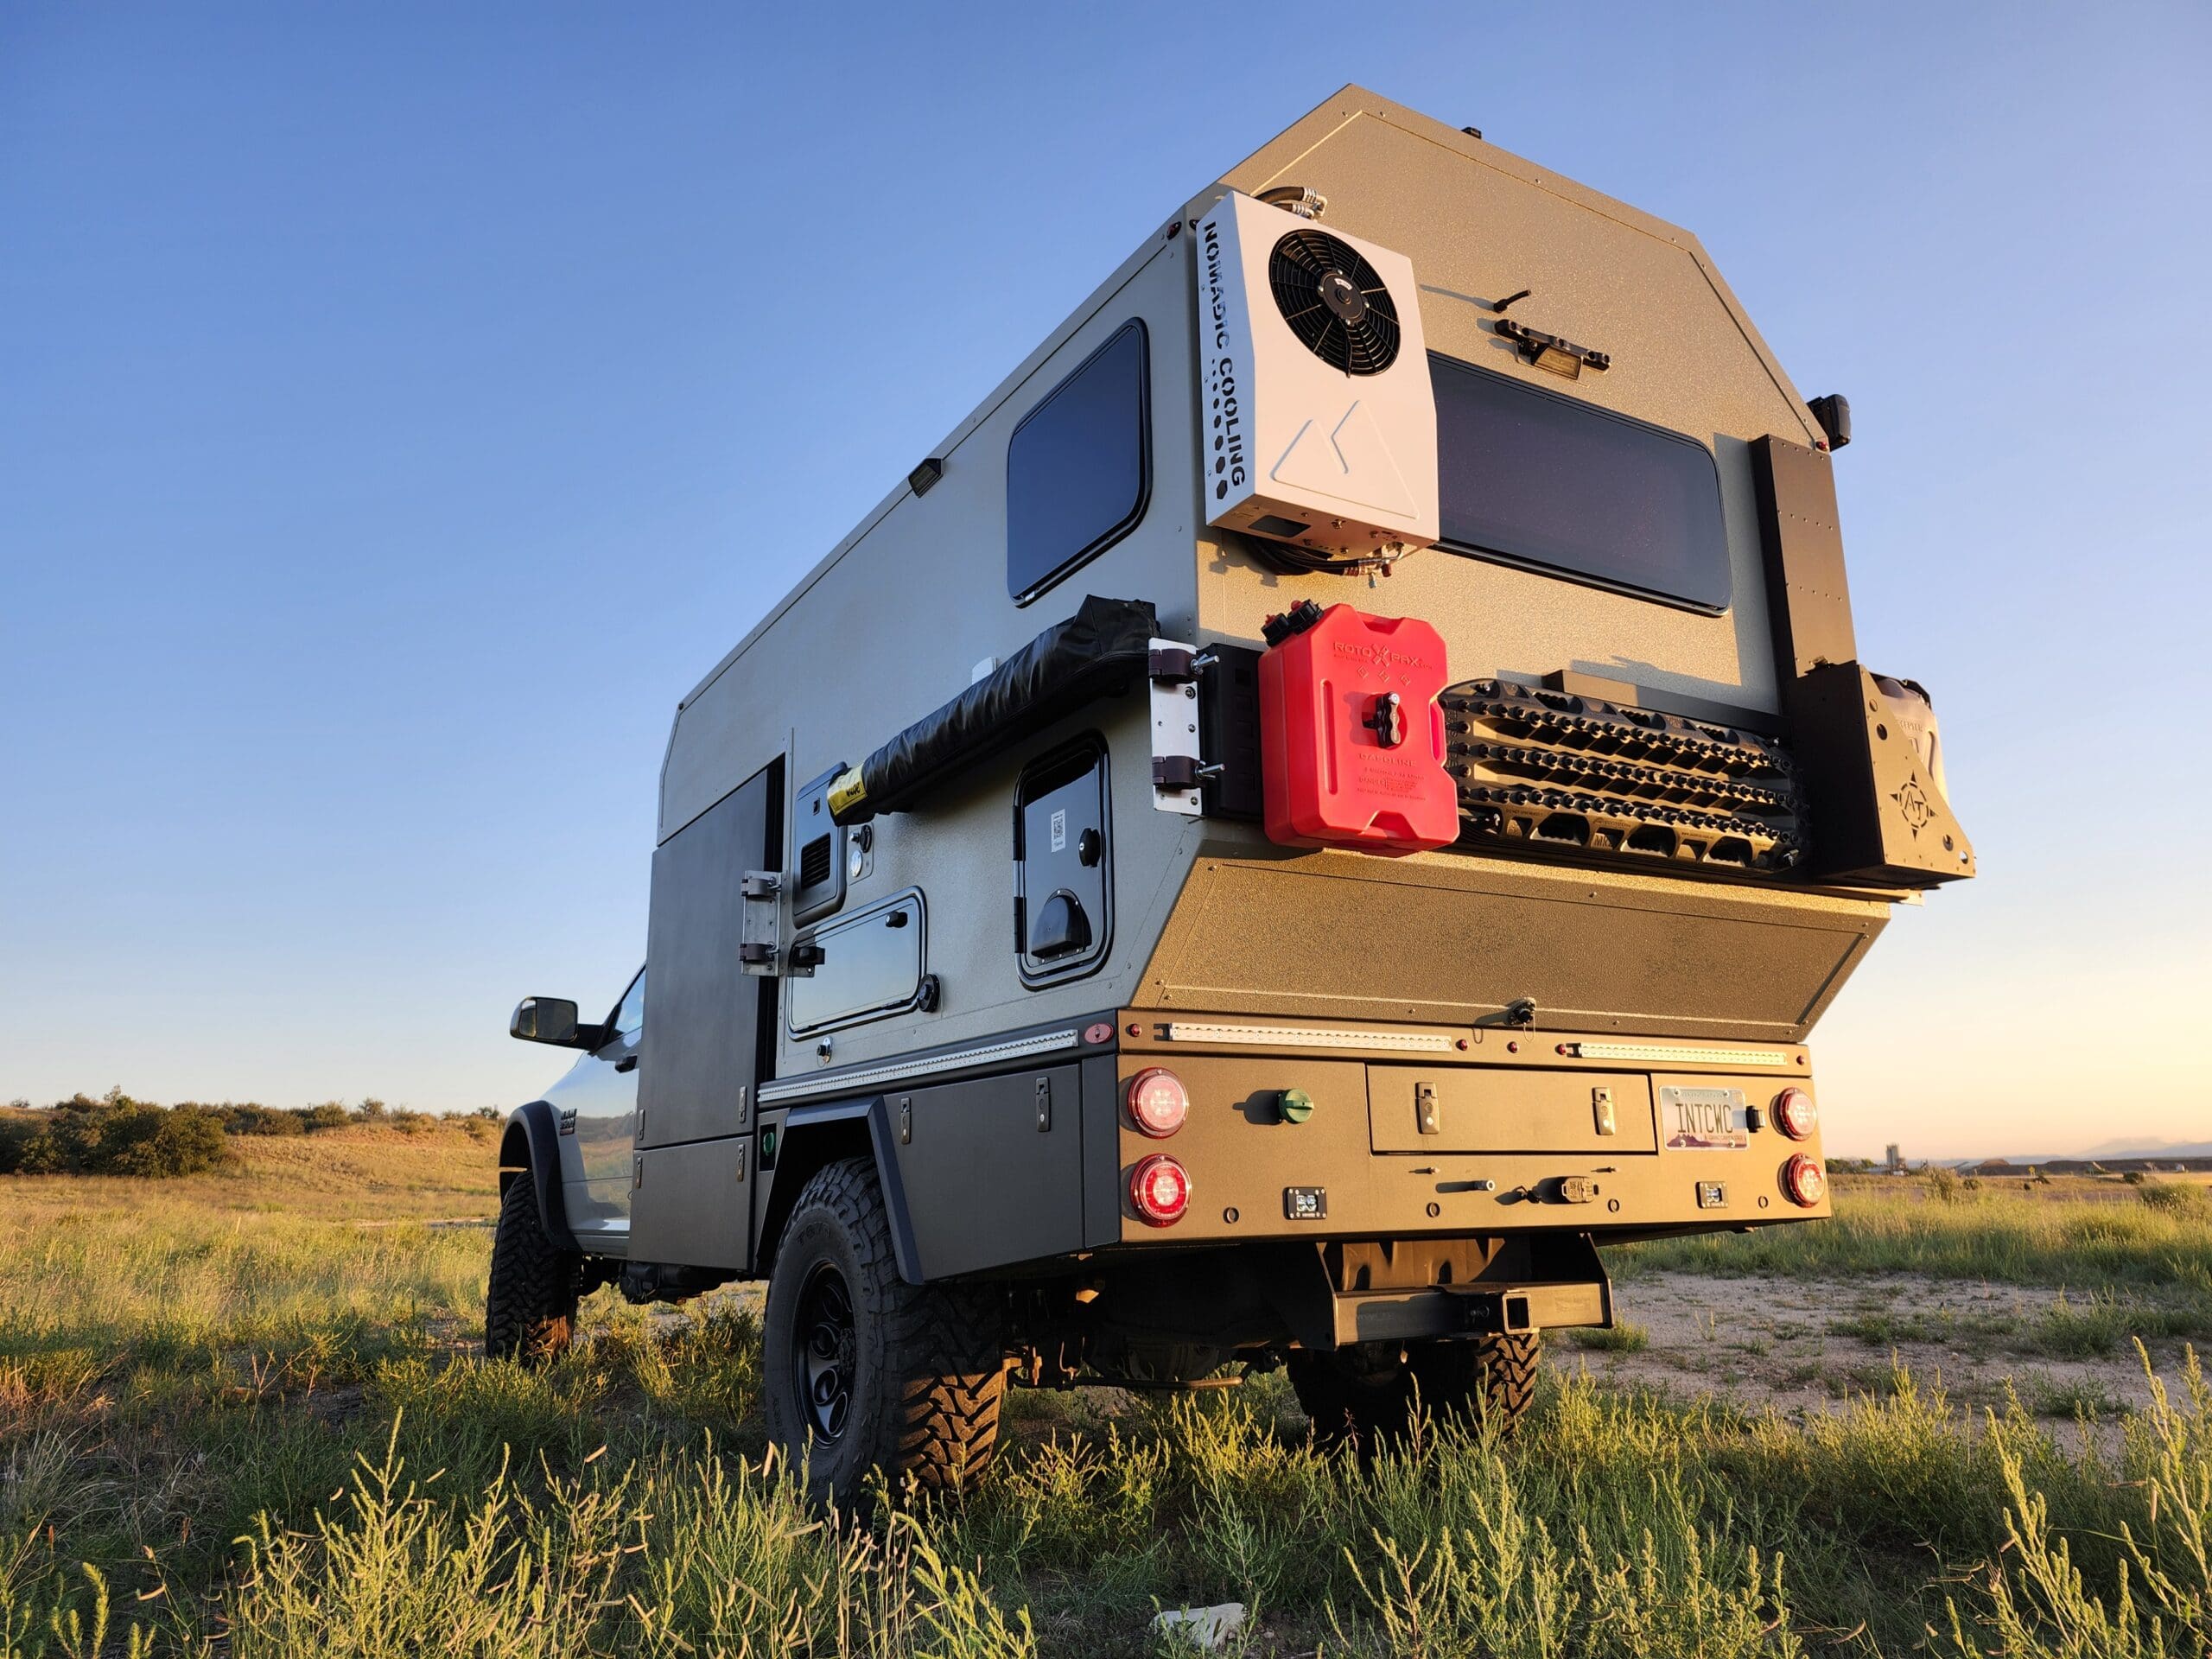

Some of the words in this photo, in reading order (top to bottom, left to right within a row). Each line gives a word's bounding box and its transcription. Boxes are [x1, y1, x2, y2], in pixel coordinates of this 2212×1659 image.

[1204, 221, 1230, 350] NOMADIC
[1219, 357, 1246, 486] COOLING
[1675, 1102, 1734, 1135] INTCWC
